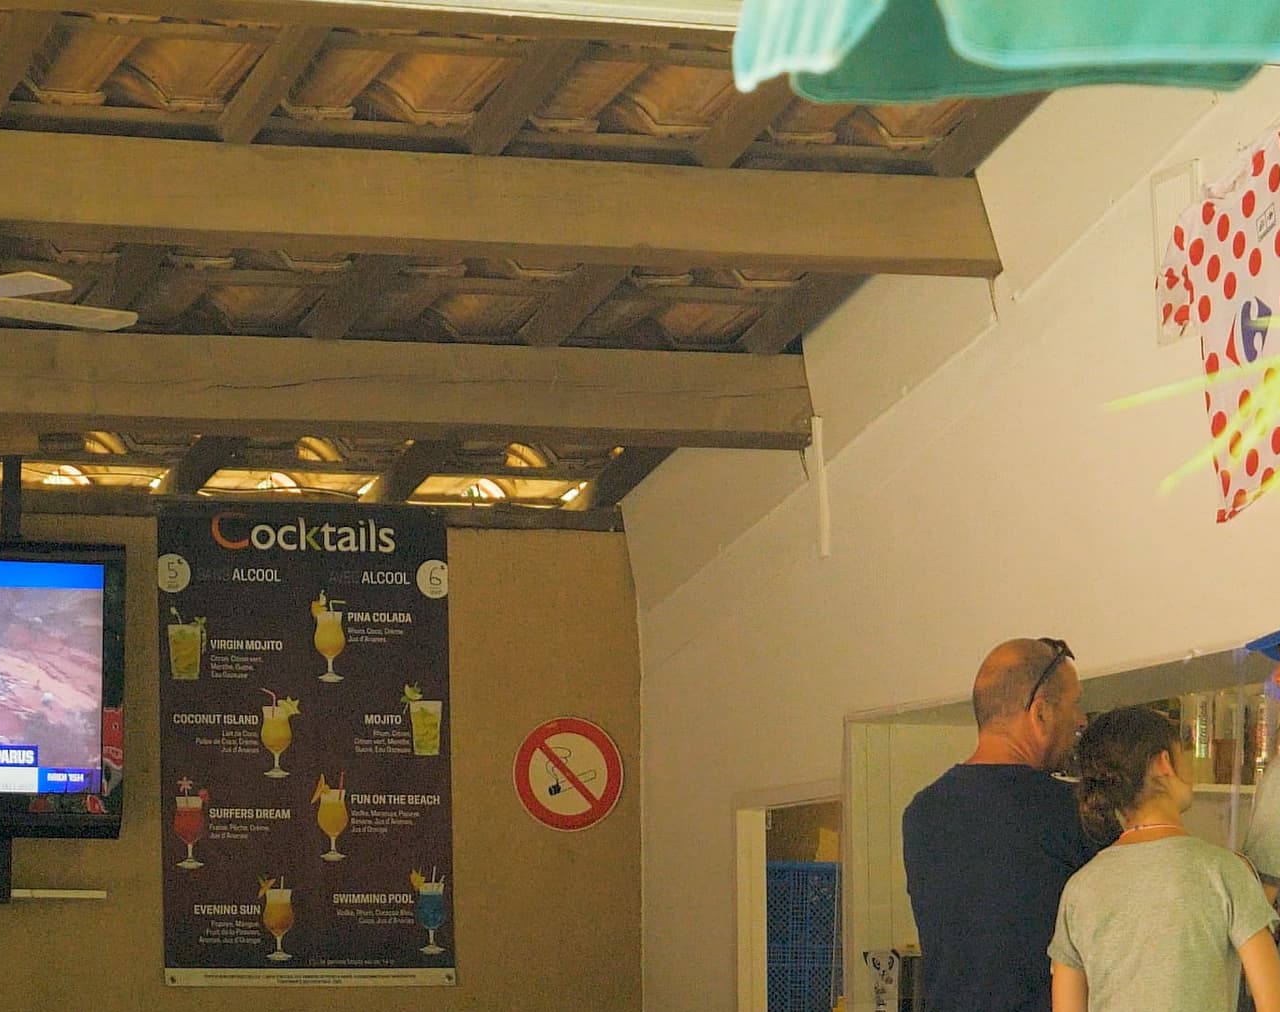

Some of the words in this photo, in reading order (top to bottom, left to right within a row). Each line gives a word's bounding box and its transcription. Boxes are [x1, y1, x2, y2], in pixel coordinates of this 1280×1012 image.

[211, 511, 397, 553] Cocktails
[232, 567, 282, 583] ALCOOL
[361, 570, 412, 586] ALCOOL
[347, 612, 371, 623] PINA
[372, 612, 412, 624] COLADA
[210, 639, 244, 651] VIRGIN
[245, 640, 283, 652] MOJITO
[173, 713, 221, 725] COCONUT
[223, 714, 259, 726] ISLAND
[364, 714, 402, 726] MOJITO
[351, 793, 372, 805] FUN
[373, 793, 386, 806] ON
[387, 794, 406, 806] THE
[407, 794, 441, 806] BEACH
[209, 808, 255, 820] SURFERS
[256, 808, 291, 820] DREAM
[332, 892, 387, 904] SWIMMING
[388, 893, 414, 905] POOL
[193, 904, 239, 916] EVENING
[239, 904, 261, 916] SUN
